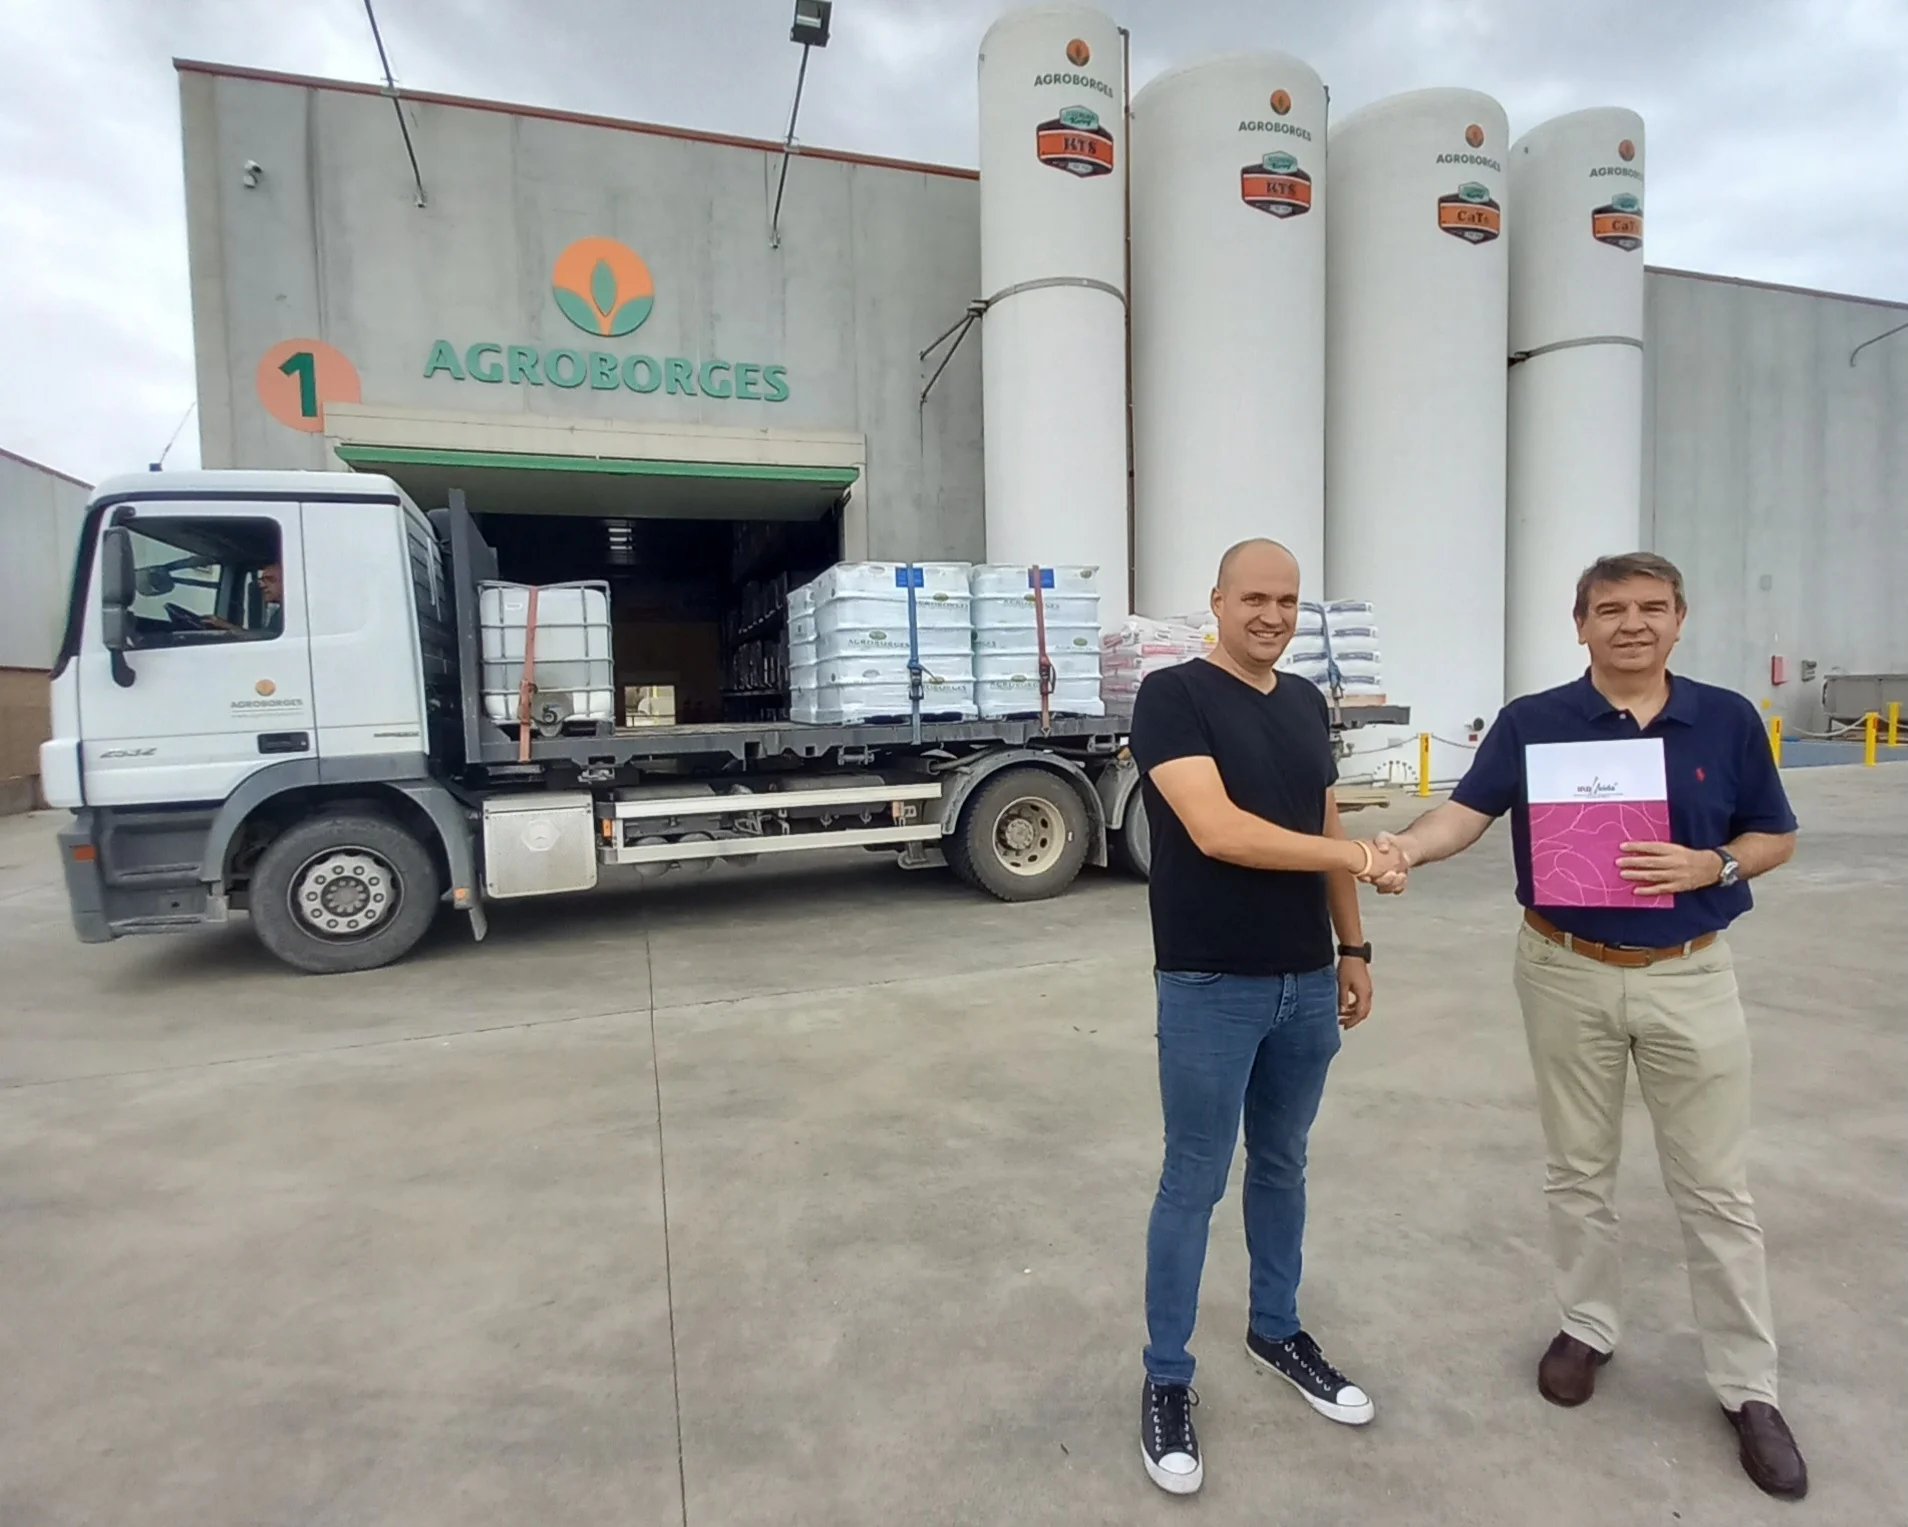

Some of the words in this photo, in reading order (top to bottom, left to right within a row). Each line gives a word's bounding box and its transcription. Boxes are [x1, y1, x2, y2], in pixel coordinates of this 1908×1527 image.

[1034, 73, 1113, 98] AGROBORGES
[1238, 121, 1312, 142] AGROBORGES
[1436, 154, 1501, 172] AGROBORGES
[423, 339, 790, 403] AGROBORGES
[278, 352, 318, 418] 1
